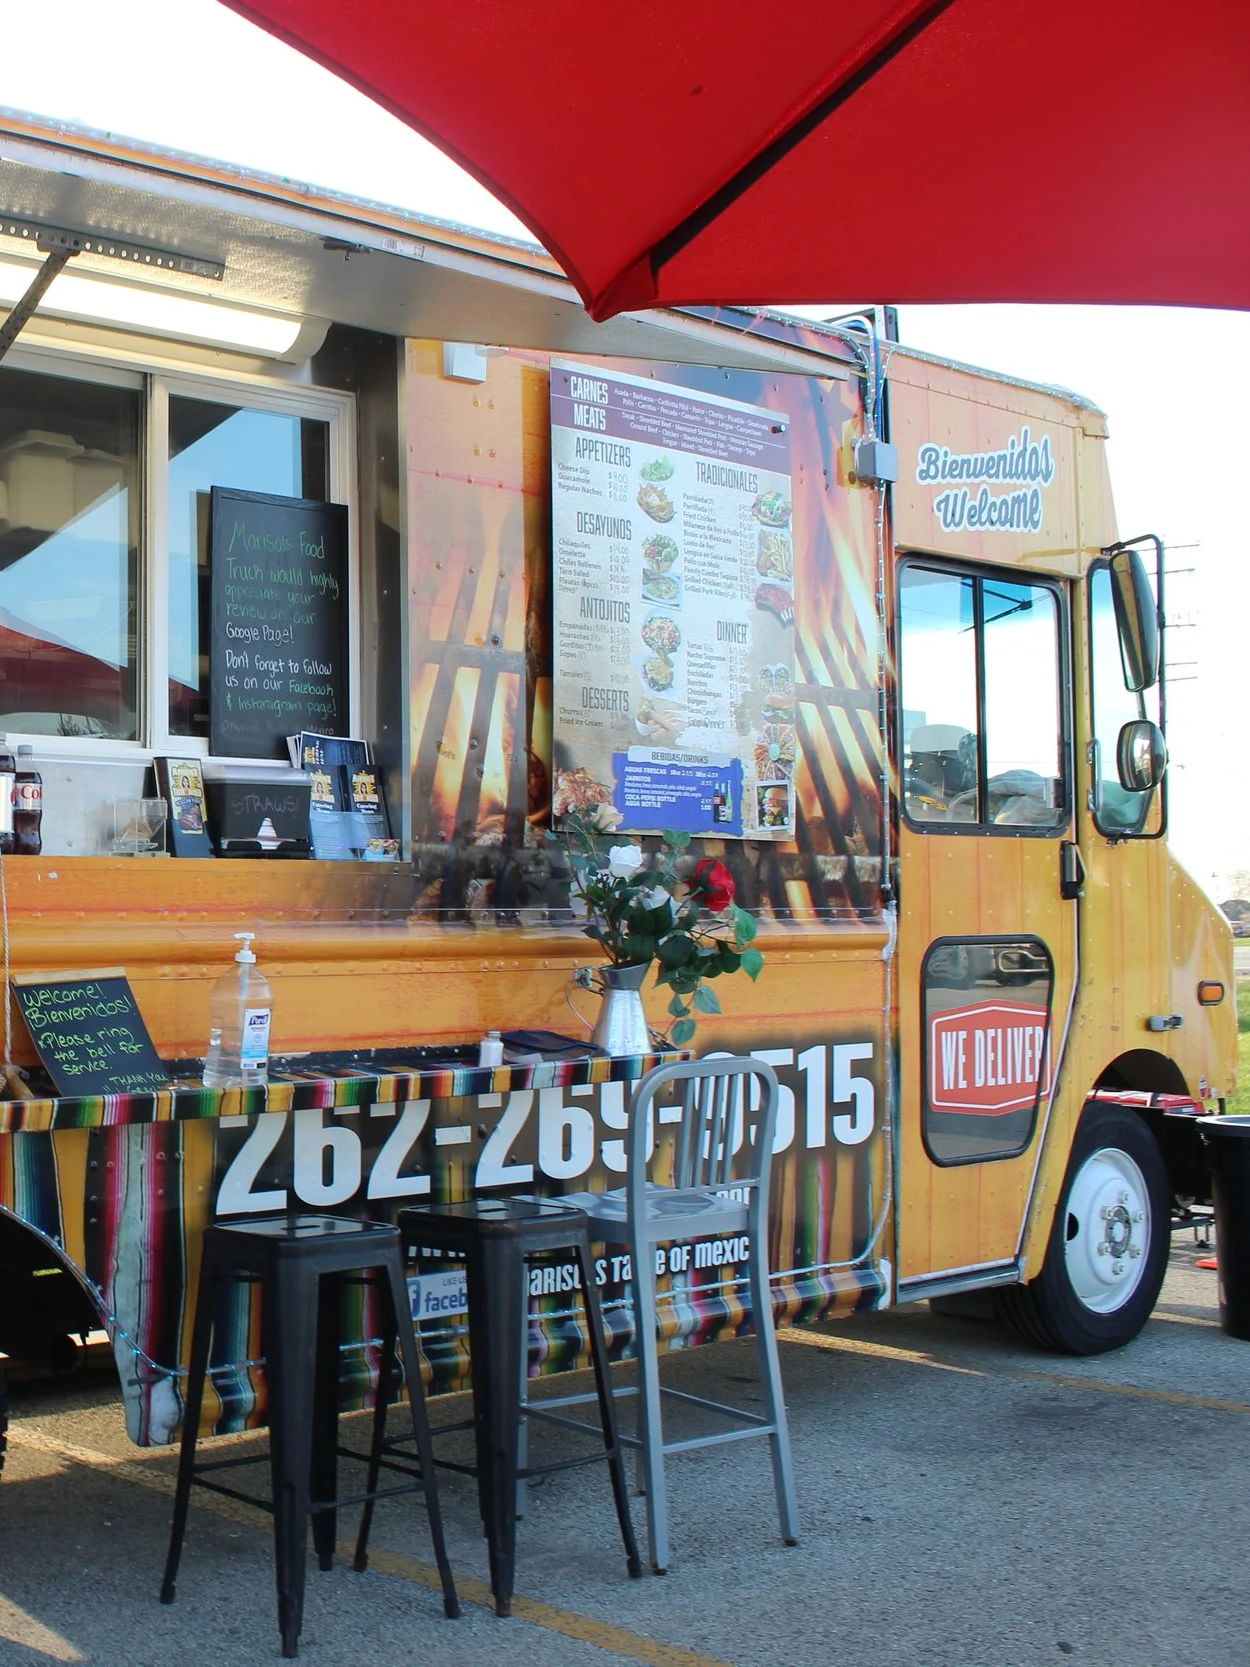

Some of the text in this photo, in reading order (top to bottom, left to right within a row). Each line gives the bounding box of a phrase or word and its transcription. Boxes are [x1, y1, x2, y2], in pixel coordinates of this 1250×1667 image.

[570, 375, 608, 405] CARNES
[574, 403, 606, 431] MEATS
[575, 437, 631, 468] APPETIZERS
[917, 428, 1053, 484] Bienvenidos
[557, 462, 578, 473] Cheese
[579, 466, 590, 475] Dip
[557, 472, 591, 485] Guacamole
[695, 461, 758, 493] TRADICIONALES
[581, 486, 603, 497] Nachos
[936, 487, 1041, 530] Welcome
[576, 511, 632, 541] DESAYUNOS
[300, 531, 325, 559] Food
[270, 567, 303, 586] would
[558, 566, 590, 578] Taco Salad
[579, 596, 631, 624] ANTOJITOS
[225, 621, 260, 644] Google
[716, 620, 748, 644] DINNER
[255, 654, 285, 678] forget
[288, 659, 299, 674] to
[303, 658, 332, 675] follow
[225, 674, 334, 696] us on our Facebook
[581, 686, 629, 712] DESSERTS
[558, 716, 575, 725] Fried
[651, 751, 709, 764] BEBIDAS/DRINKS
[23, 983, 107, 1008] Welcome!
[97, 1027, 134, 1045] ring
[54, 1041, 144, 1063] the bell for
[941, 1026, 1044, 1090] WE DELIVER
[109, 1074, 146, 1086] THANK
[424, 1287, 468, 1312] faceb
